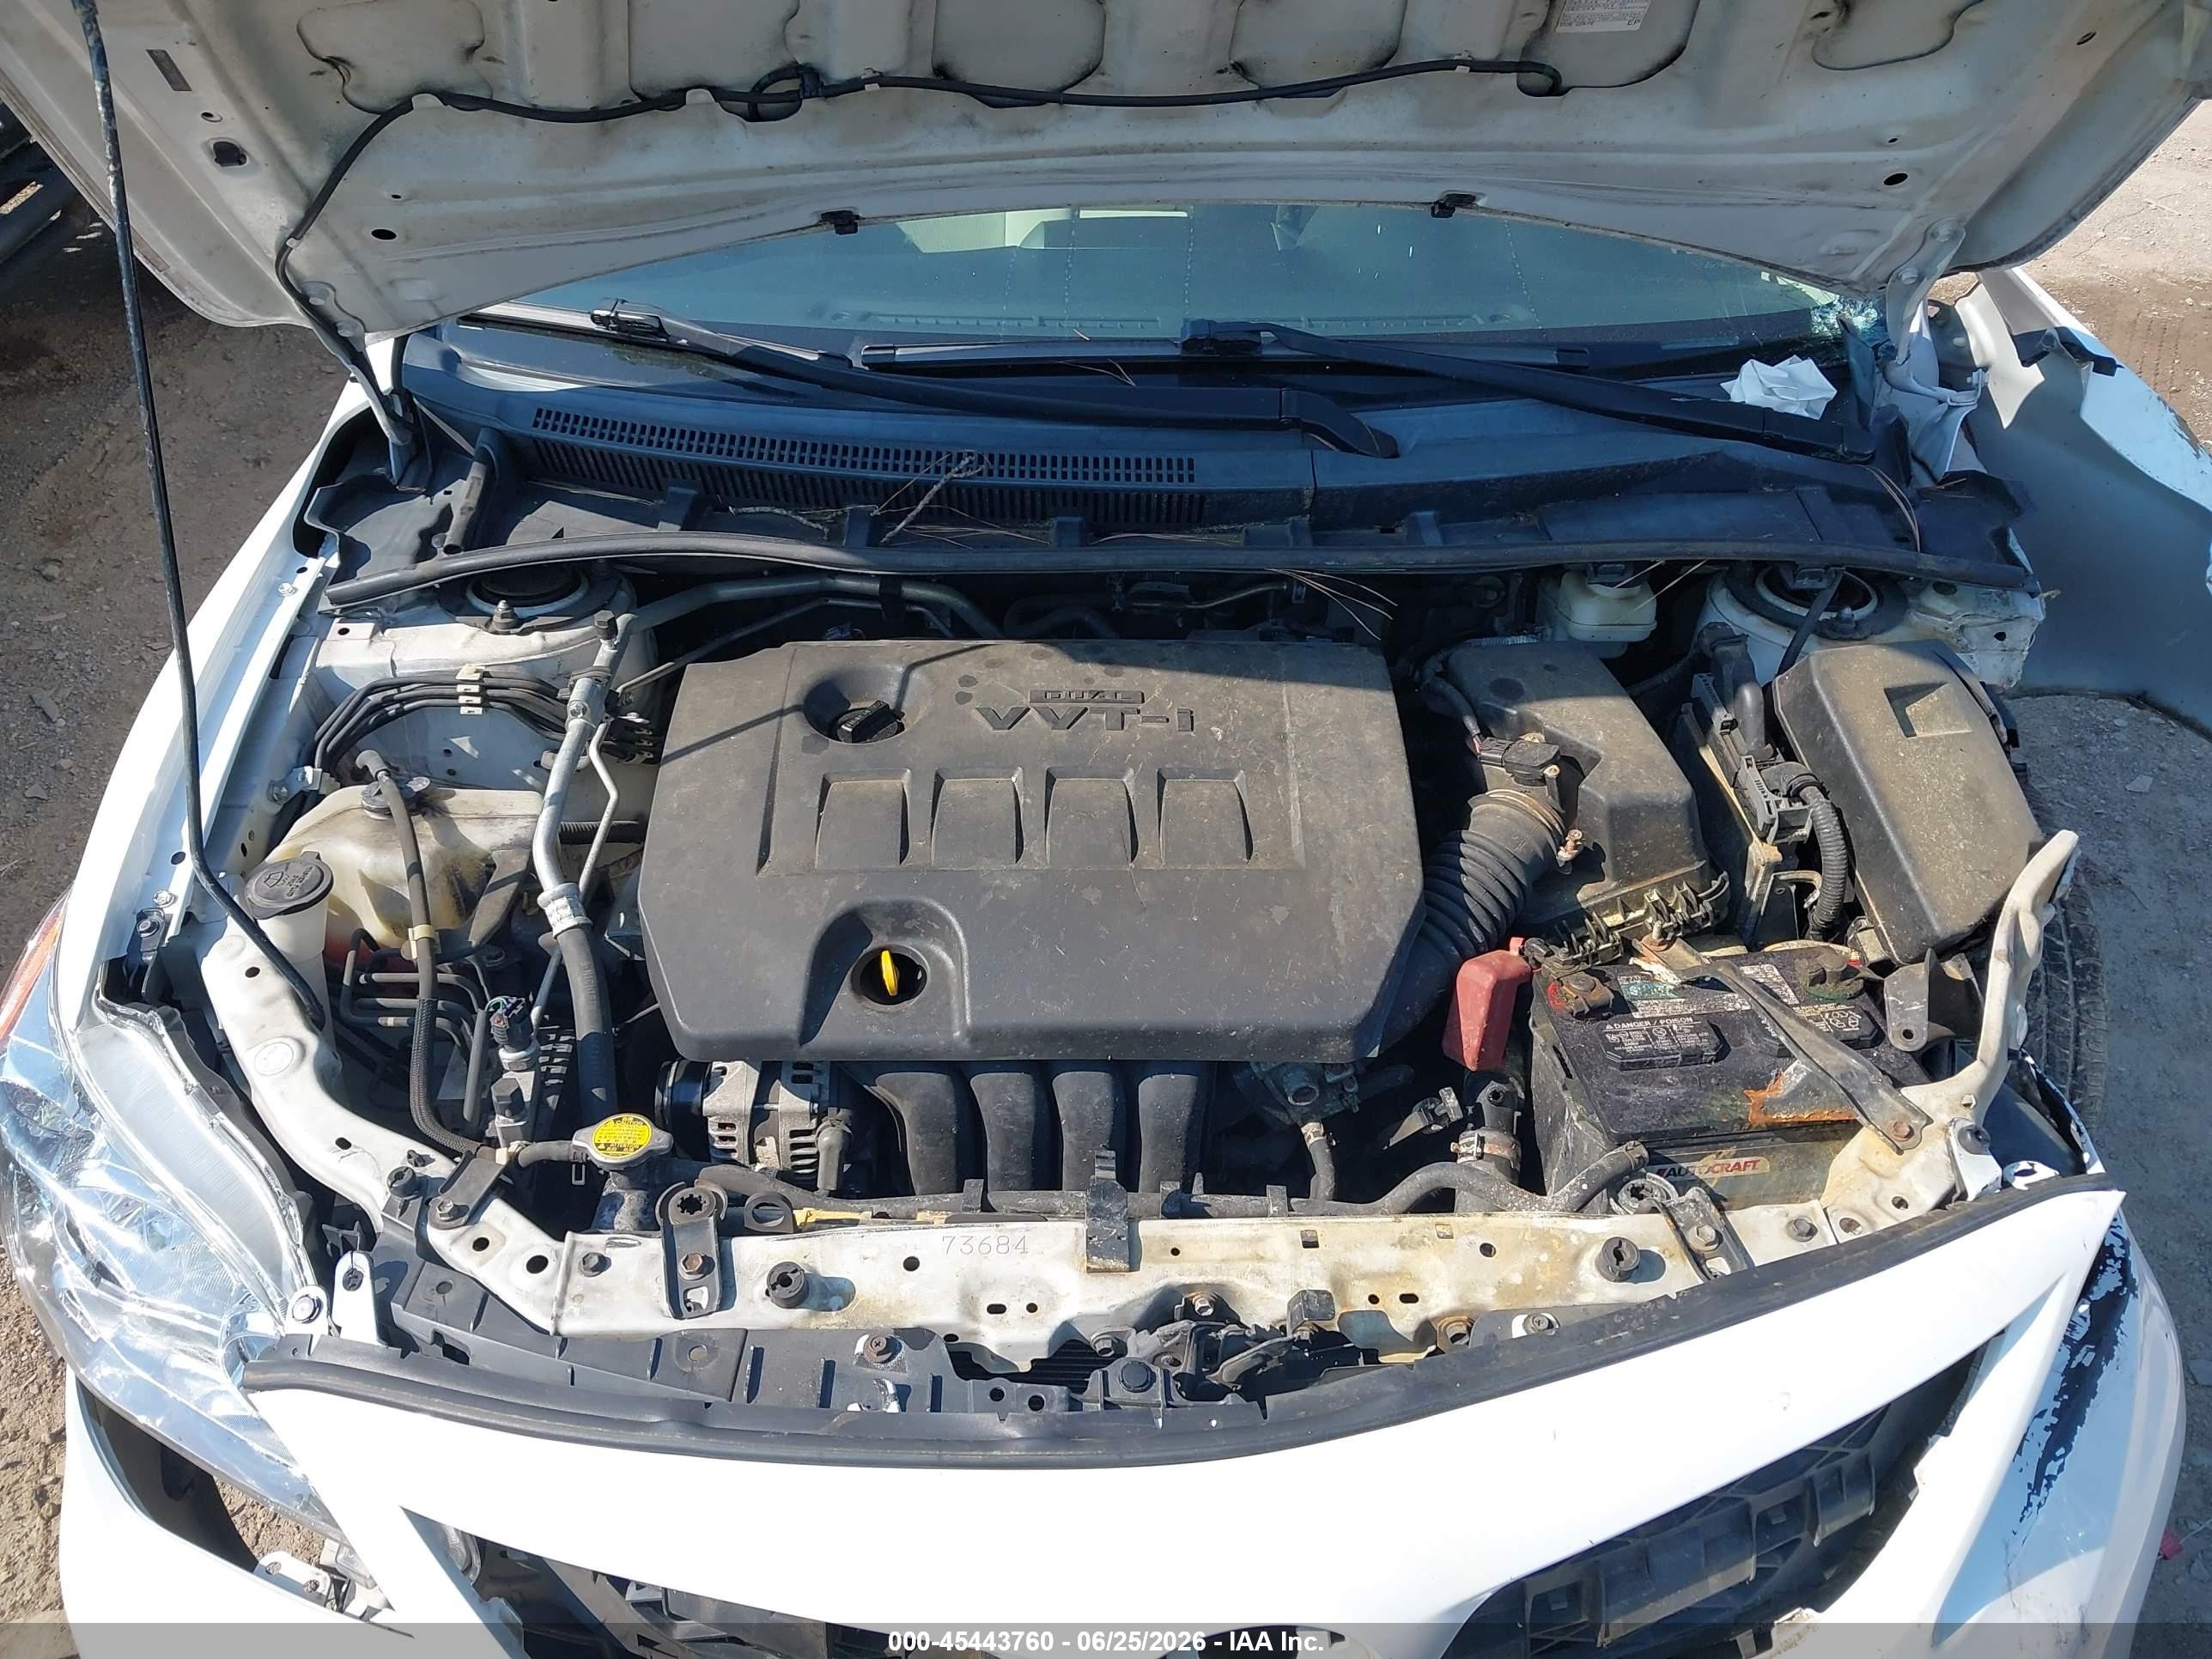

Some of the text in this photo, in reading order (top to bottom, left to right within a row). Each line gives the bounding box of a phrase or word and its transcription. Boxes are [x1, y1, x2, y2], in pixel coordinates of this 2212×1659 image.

[1044, 690, 1135, 700] DUAL
[1614, 1020, 1650, 1030] DANGER
[1659, 1017, 1693, 1025] POISON
[942, 1235, 1029, 1255] 73684
